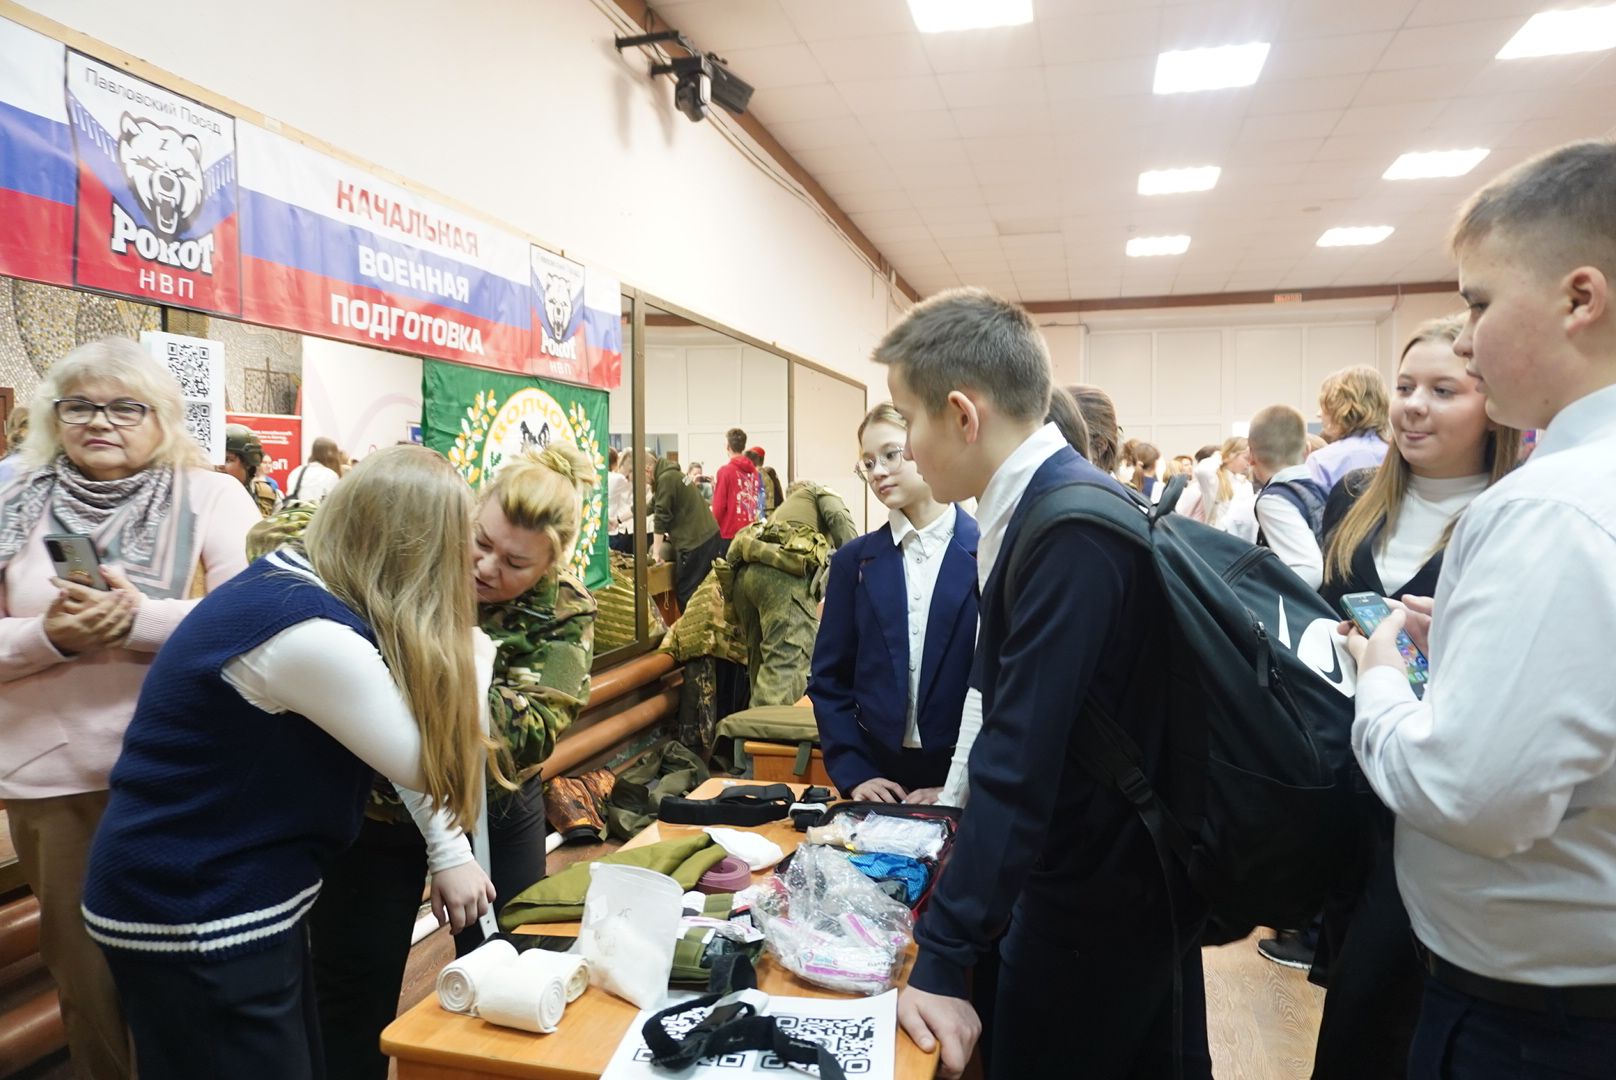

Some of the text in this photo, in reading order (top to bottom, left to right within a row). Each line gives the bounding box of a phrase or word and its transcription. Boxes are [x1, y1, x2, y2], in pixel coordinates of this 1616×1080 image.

[85, 67, 222, 136] Павловский Посад
[336, 179, 479, 257] НАЧАЛЬНАЯ
[139, 268, 194, 299] НВП
[358, 244, 469, 304] ВОЕННАЯ
[331, 292, 485, 356] ПОДГОТОВКА
